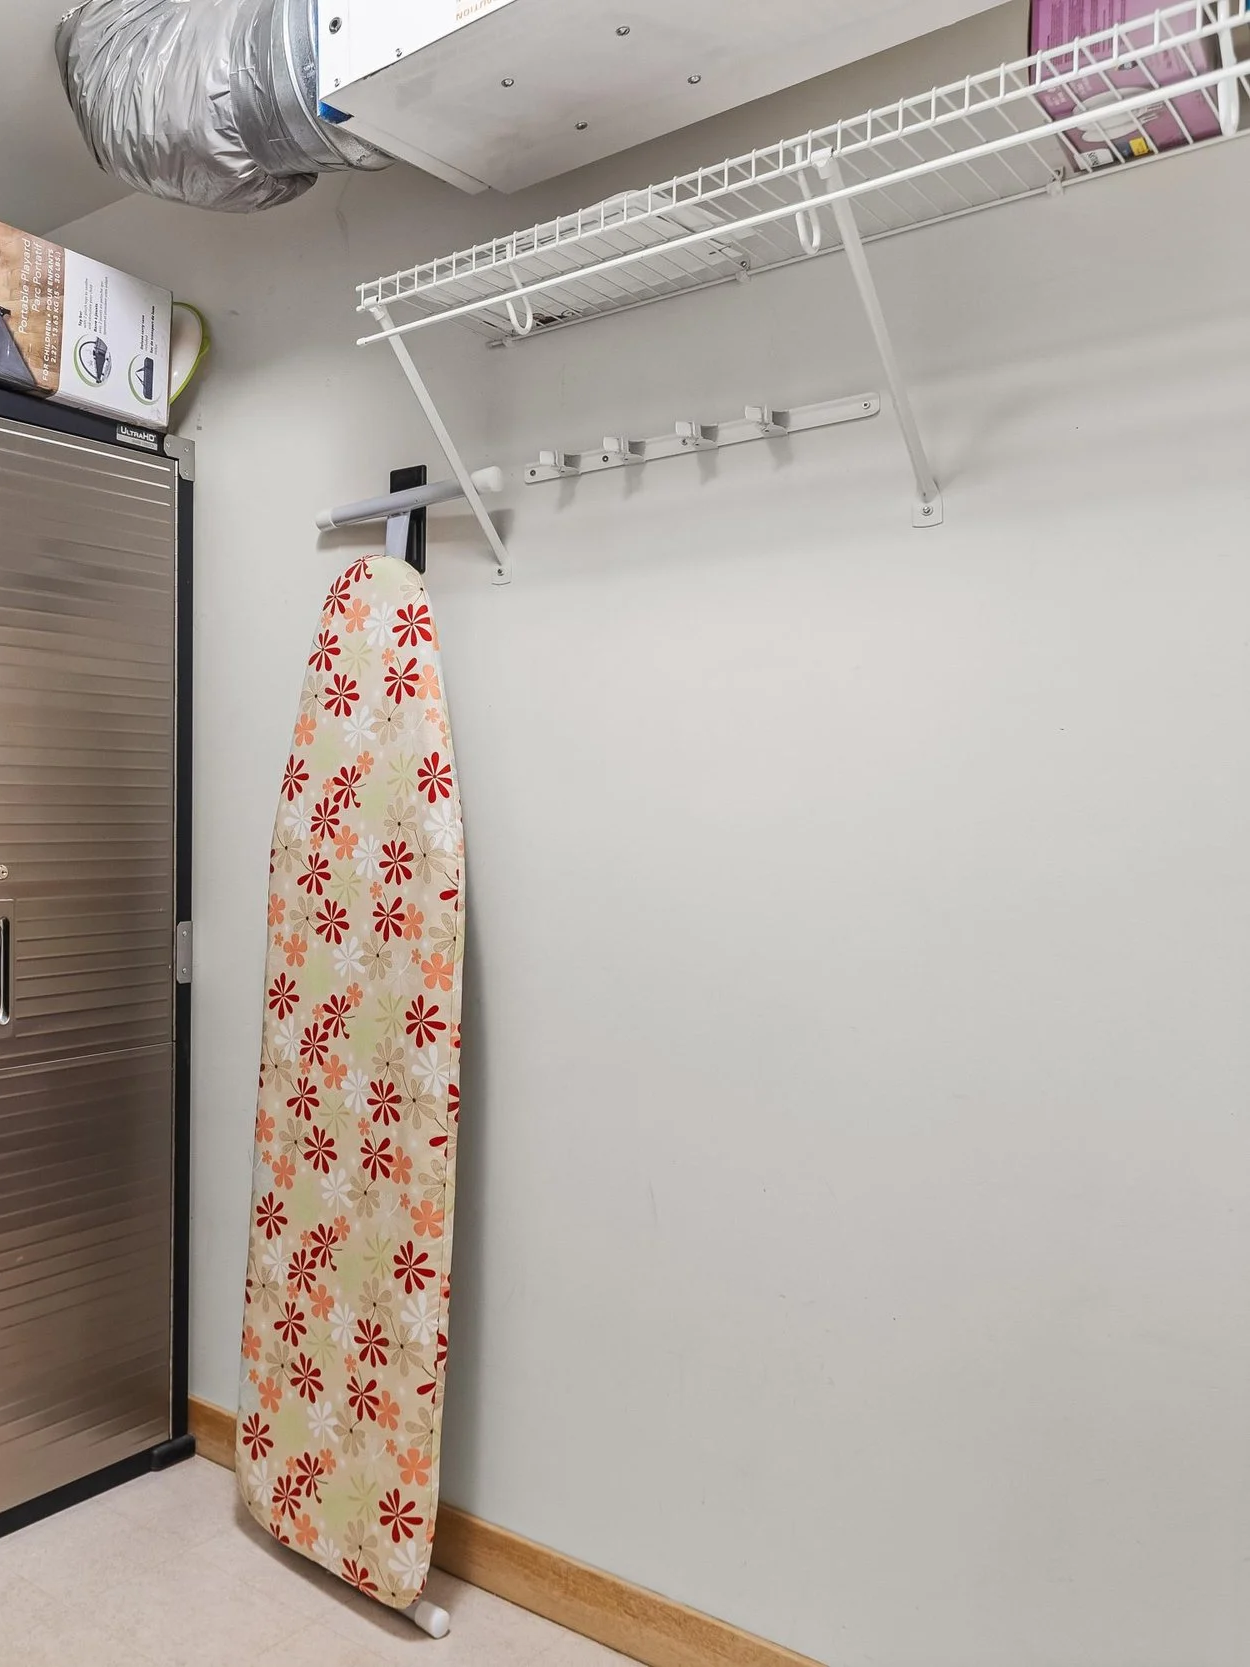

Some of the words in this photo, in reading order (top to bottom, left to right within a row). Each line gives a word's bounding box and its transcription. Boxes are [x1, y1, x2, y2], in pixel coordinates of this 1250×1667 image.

[456, 0, 495, 20] AUTION
[21, 238, 32, 281] Playard
[33, 242, 42, 285] Portatif
[19, 285, 29, 334] Portable
[32, 287, 41, 312] Parc
[53, 301, 59, 313] KG
